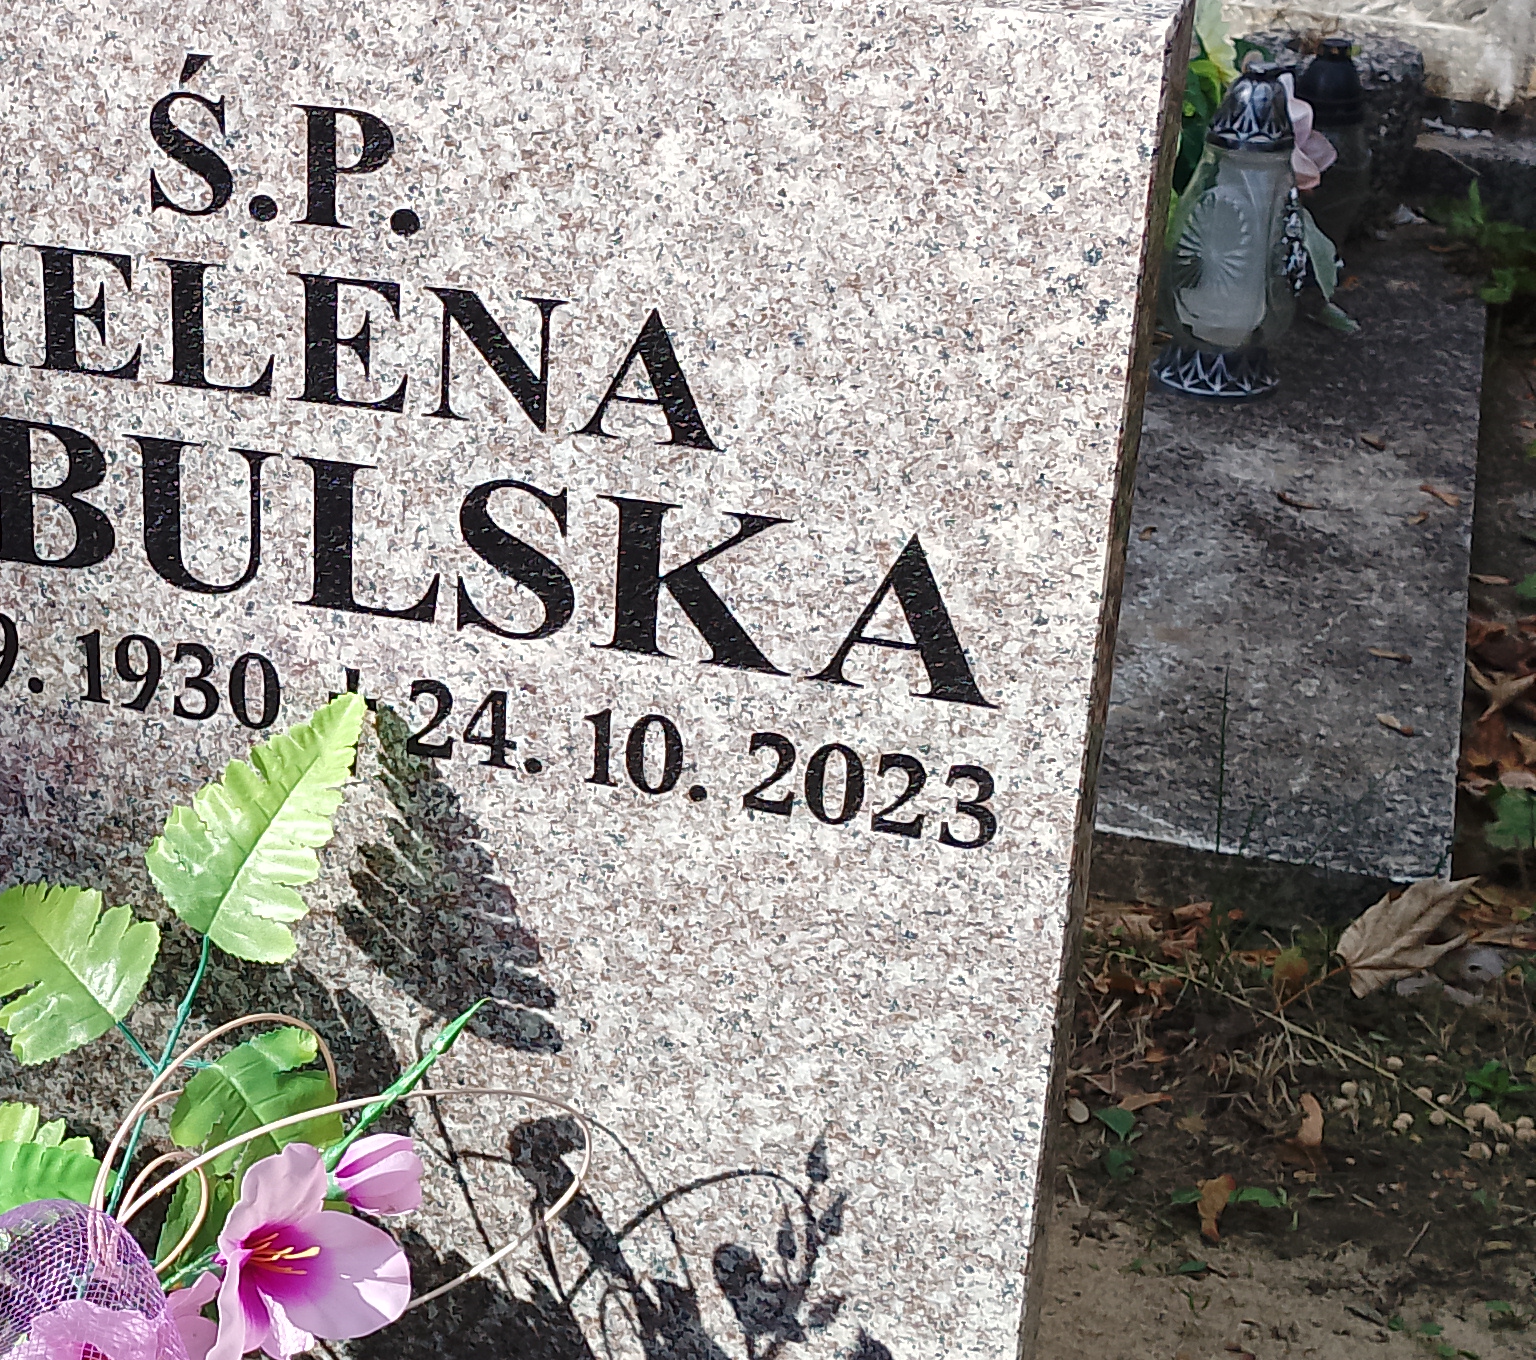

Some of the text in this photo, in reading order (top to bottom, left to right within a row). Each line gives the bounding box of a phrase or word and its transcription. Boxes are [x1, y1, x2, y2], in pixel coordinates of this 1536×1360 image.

[148, 54, 419, 236] Ś.P.
[82, 629, 281, 731] 1930
[741, 732, 999, 850] 2023
